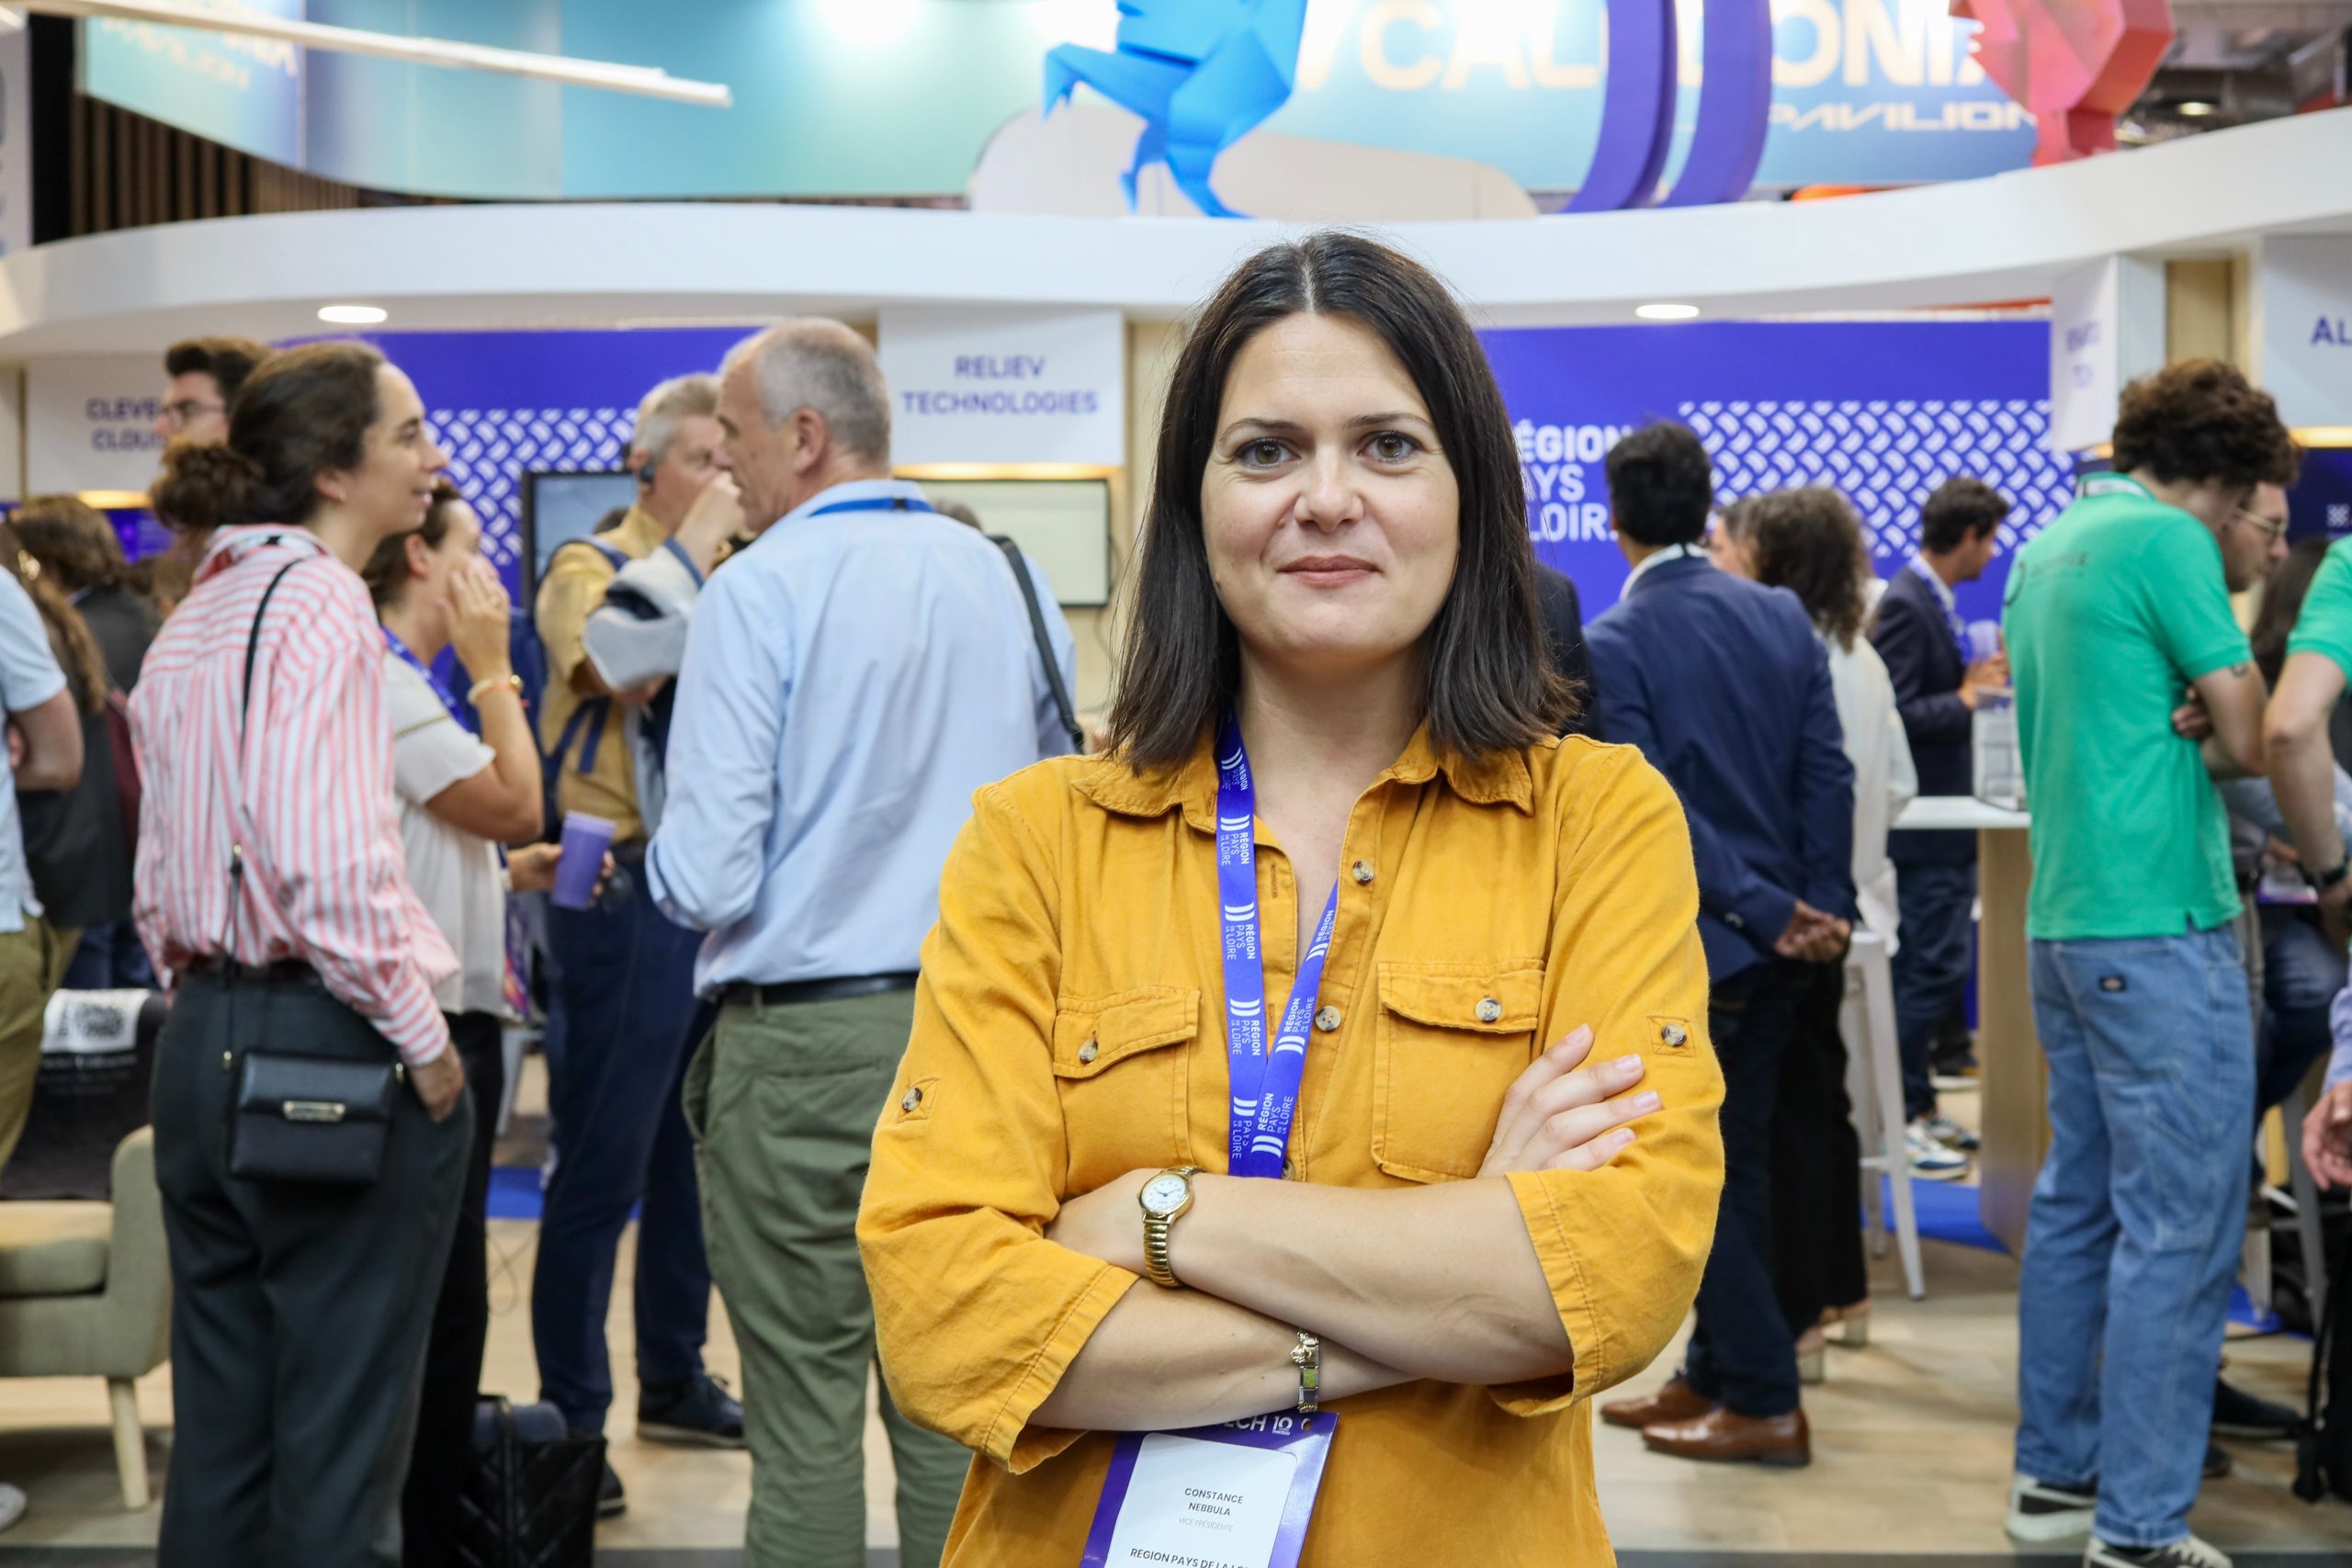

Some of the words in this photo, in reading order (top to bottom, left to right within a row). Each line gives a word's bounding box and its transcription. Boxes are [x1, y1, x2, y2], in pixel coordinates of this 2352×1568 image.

[954, 355, 1046, 379] RELIEV
[85, 398, 161, 422] CLEVE
[902, 390, 1099, 415] TECHNOLOGIES
[1221, 841, 1231, 866] LOIRE
[1230, 833, 1240, 855] PAYS
[1226, 933, 1237, 961] LOIRE
[1236, 924, 1246, 949] PAYS
[1292, 1009, 1306, 1032] PAYS
[1302, 996, 1315, 1024] LOIRE
[1231, 1028, 1242, 1055] LOIRE
[1241, 1020, 1250, 1044] PAYS
[1266, 1106, 1281, 1133] PAYS
[1279, 1095, 1295, 1125] LOIRE
[1232, 1129, 1242, 1159] LOIRE
[1184, 1487, 1244, 1505] CONSTANCE
[1188, 1502, 1232, 1517] NEBBULA
[1130, 1548, 1170, 1562] REGION
[1170, 1554, 1200, 1568] PAYS
